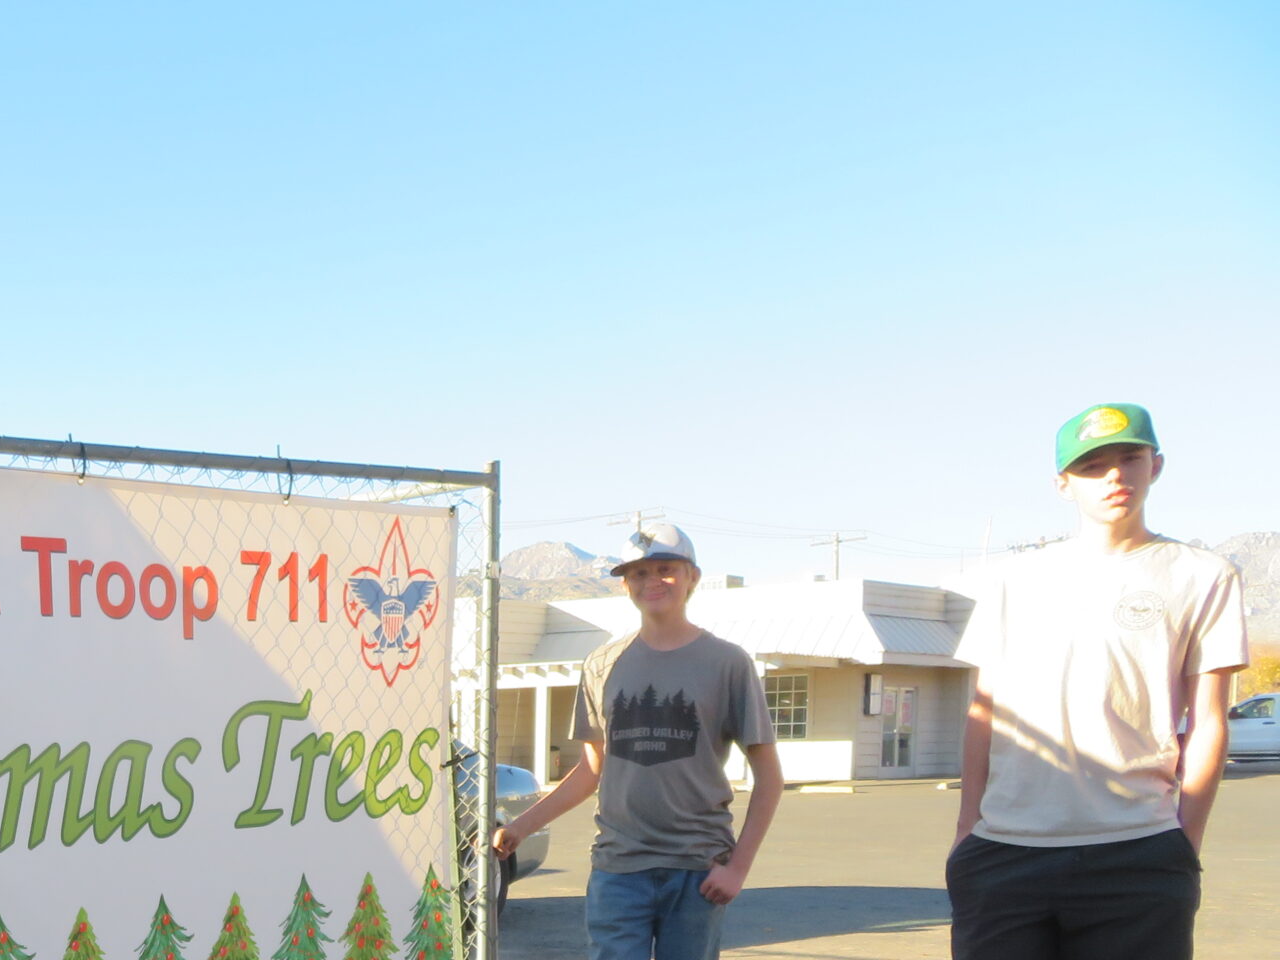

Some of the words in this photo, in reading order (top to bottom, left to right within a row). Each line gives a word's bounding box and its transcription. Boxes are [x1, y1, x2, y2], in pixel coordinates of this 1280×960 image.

[20, 536, 220, 640] Troop
[239, 550, 329, 624] 711
[222, 688, 441, 829] Trees
[652, 727, 694, 740] VALLEY
